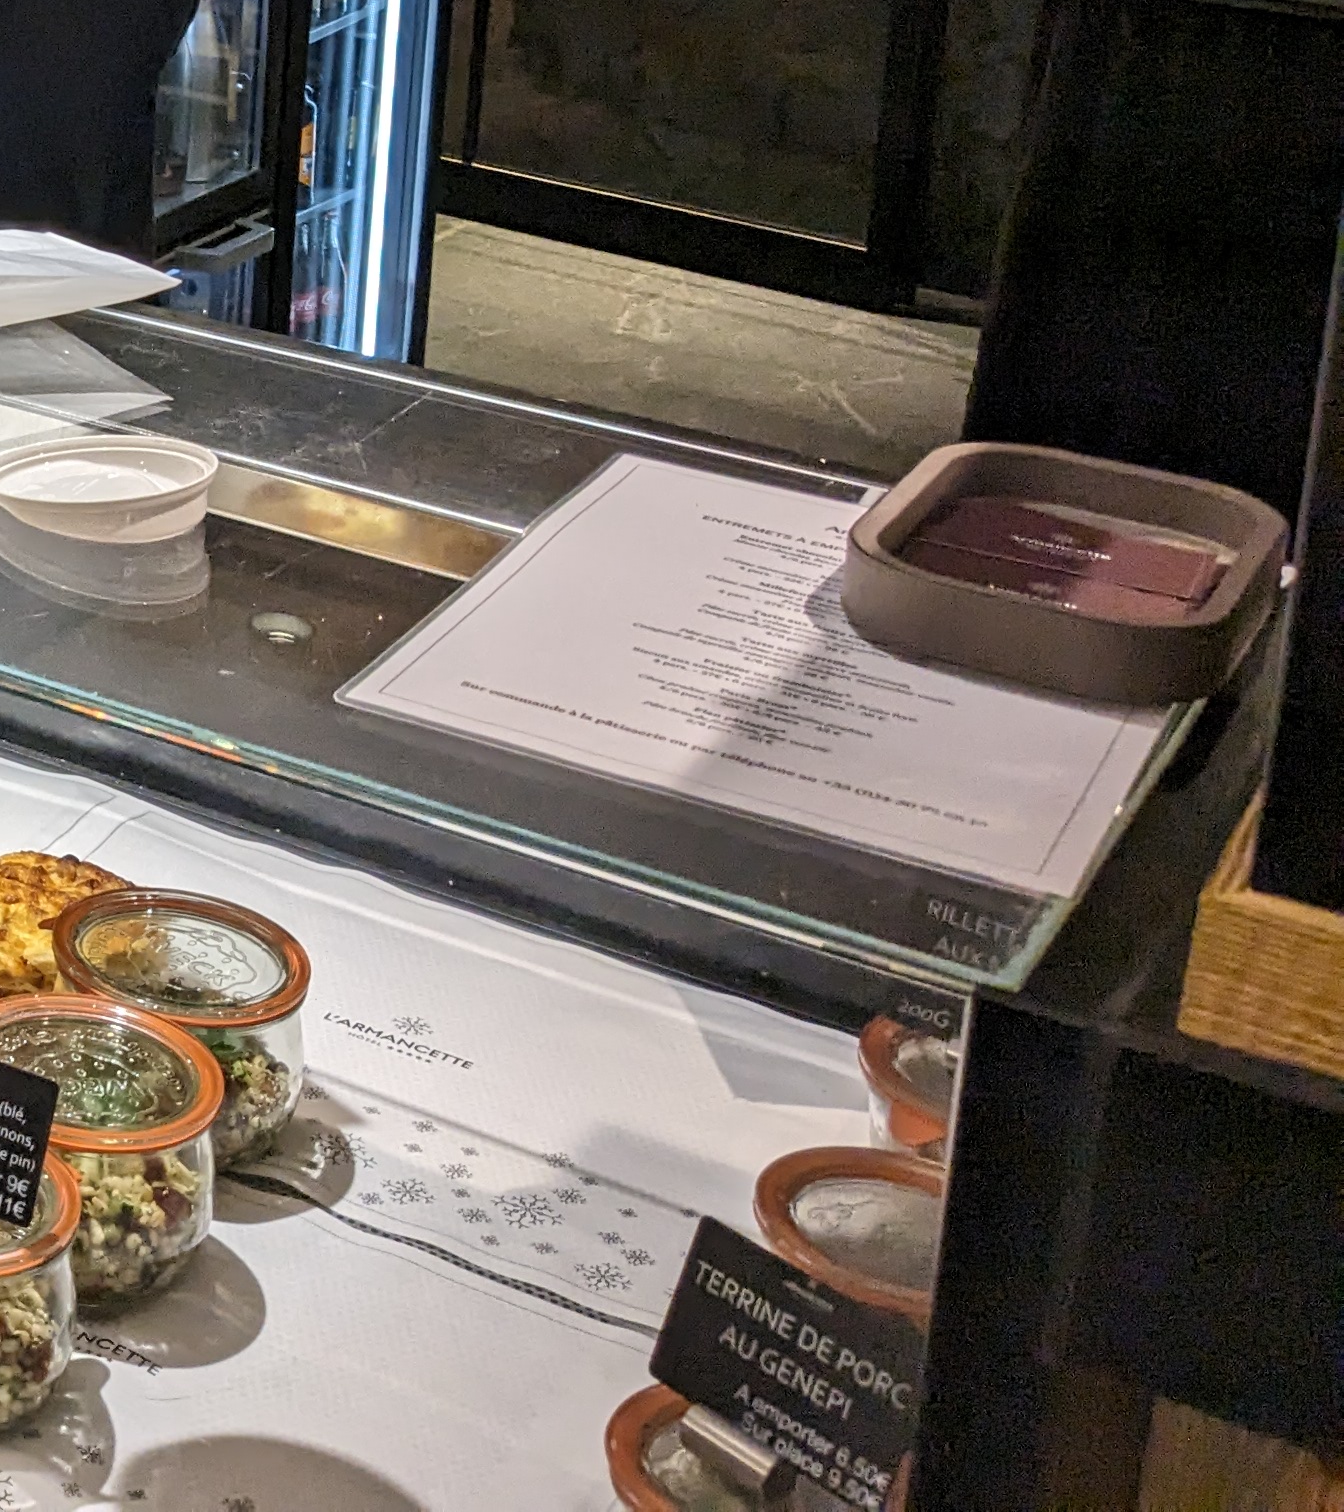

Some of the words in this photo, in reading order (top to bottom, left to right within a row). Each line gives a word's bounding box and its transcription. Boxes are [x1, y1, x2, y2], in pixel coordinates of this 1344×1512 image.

[323, 1012, 474, 1070] L'ARMANCETTE
[6, 1174, 30, 1198] 9€
[9, 1150, 36, 1173] pin)
[77, 1331, 163, 1377] NCETTE
[694, 1259, 799, 1339] TERRINE
[798, 1324, 837, 1364] DE
[836, 1347, 913, 1410] PORC
[718, 1325, 759, 1361] AU
[758, 1348, 853, 1421] GENEPI
[733, 1383, 749, 1406] A
[751, 1396, 836, 1456] emporter
[741, 1410, 773, 1444] Sur
[774, 1437, 824, 1479] place
